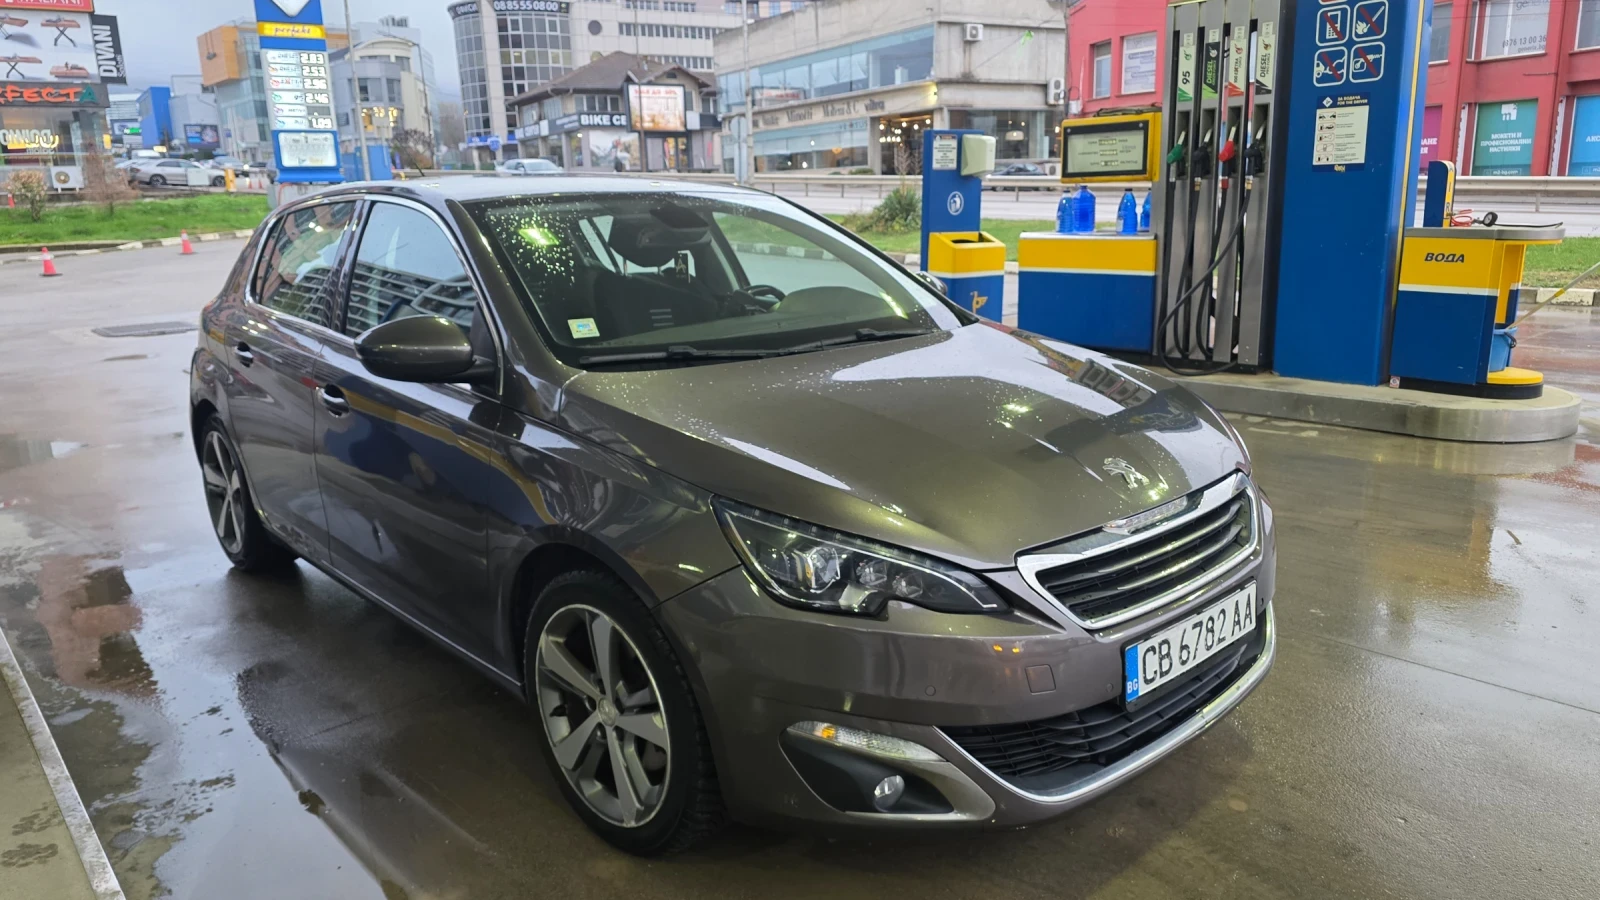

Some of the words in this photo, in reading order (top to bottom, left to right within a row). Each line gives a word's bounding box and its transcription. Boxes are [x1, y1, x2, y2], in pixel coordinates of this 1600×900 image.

[92, 25, 118, 77] DIVANI
[1259, 53, 1267, 77] DIESEL
[1182, 71, 1191, 85] 95
[580, 114, 611, 126] BIKE
[1480, 139, 1532, 147] ПРОФЕСИОНАЛНИ
[1424, 252, 1465, 263] ВОДА
[1178, 608, 1226, 666] 6782
[1127, 678, 1139, 694] BG
